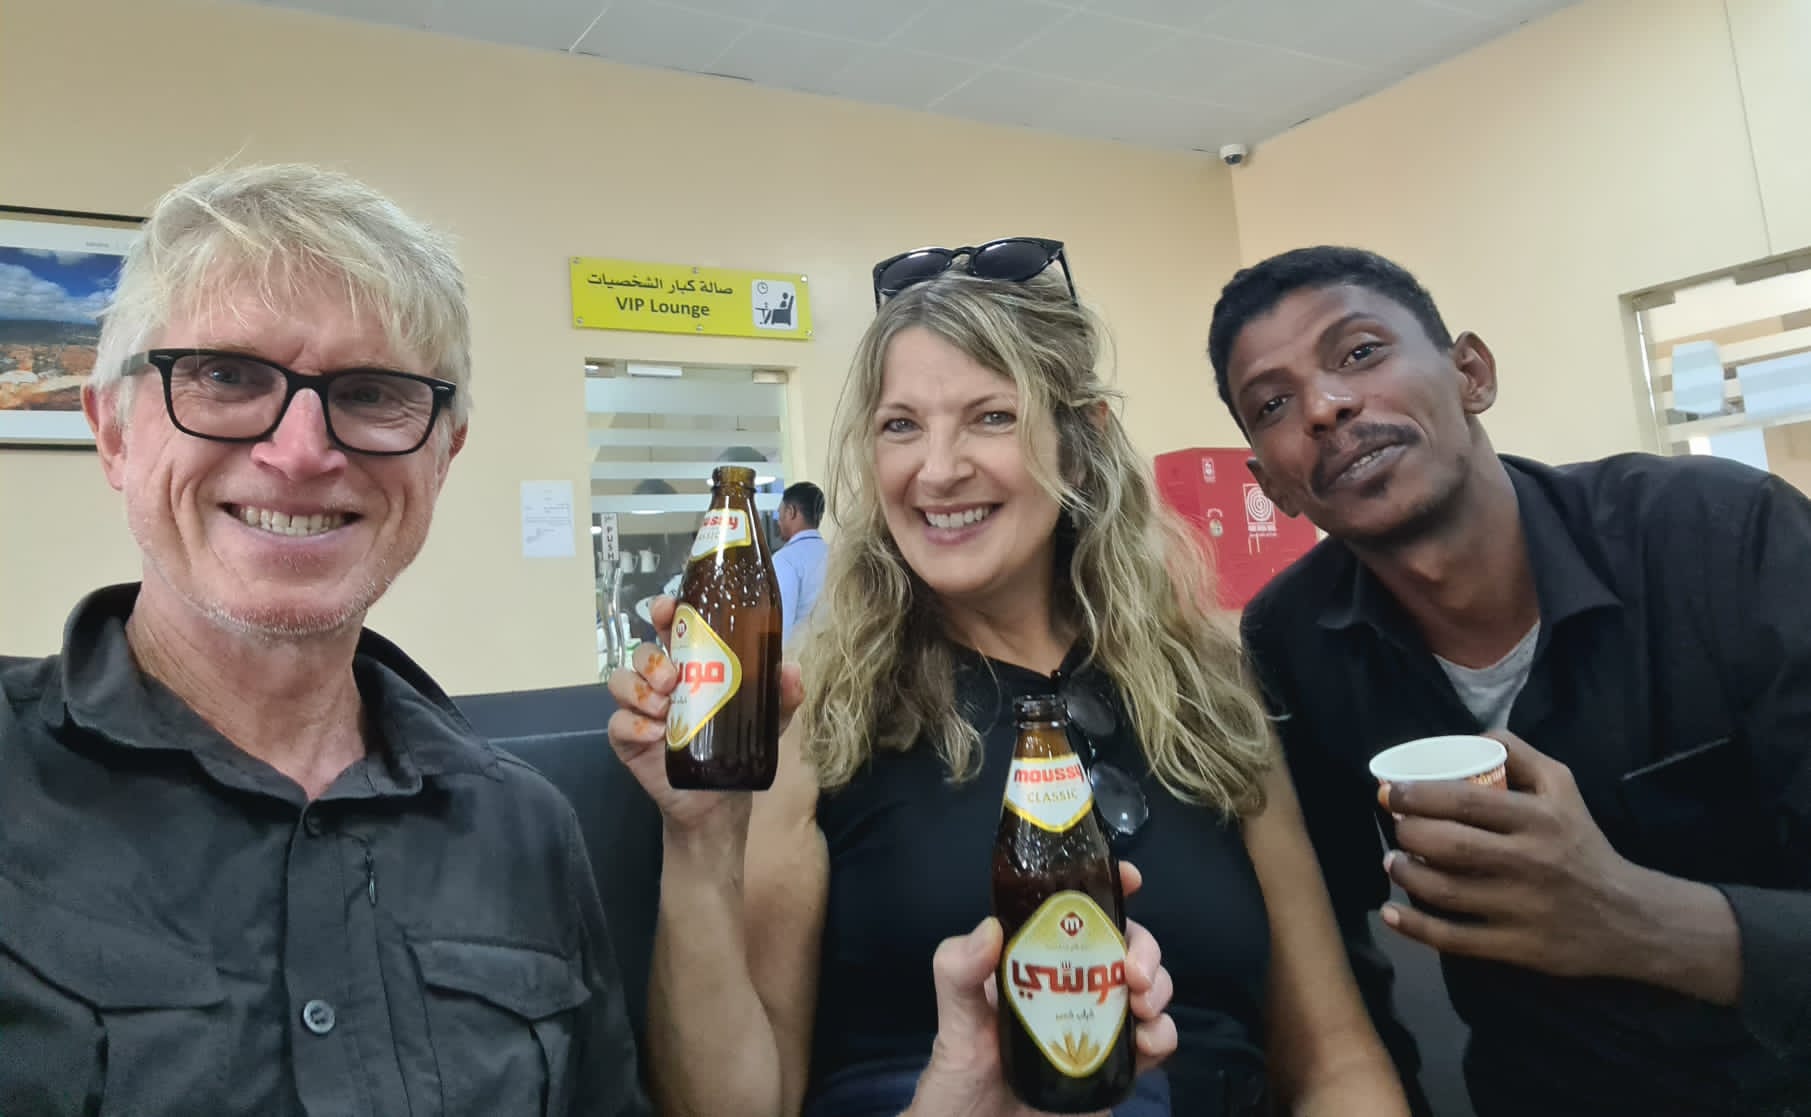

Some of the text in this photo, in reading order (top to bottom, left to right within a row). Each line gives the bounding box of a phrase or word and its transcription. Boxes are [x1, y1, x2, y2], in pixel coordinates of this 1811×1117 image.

[588, 273, 733, 295] صالة كبار الشخصيات
[616, 296, 710, 319] VIP Lounge
[607, 526, 615, 560] PUSH
[1014, 763, 1084, 784] moussy
[1026, 788, 1078, 804] CLASSIC
